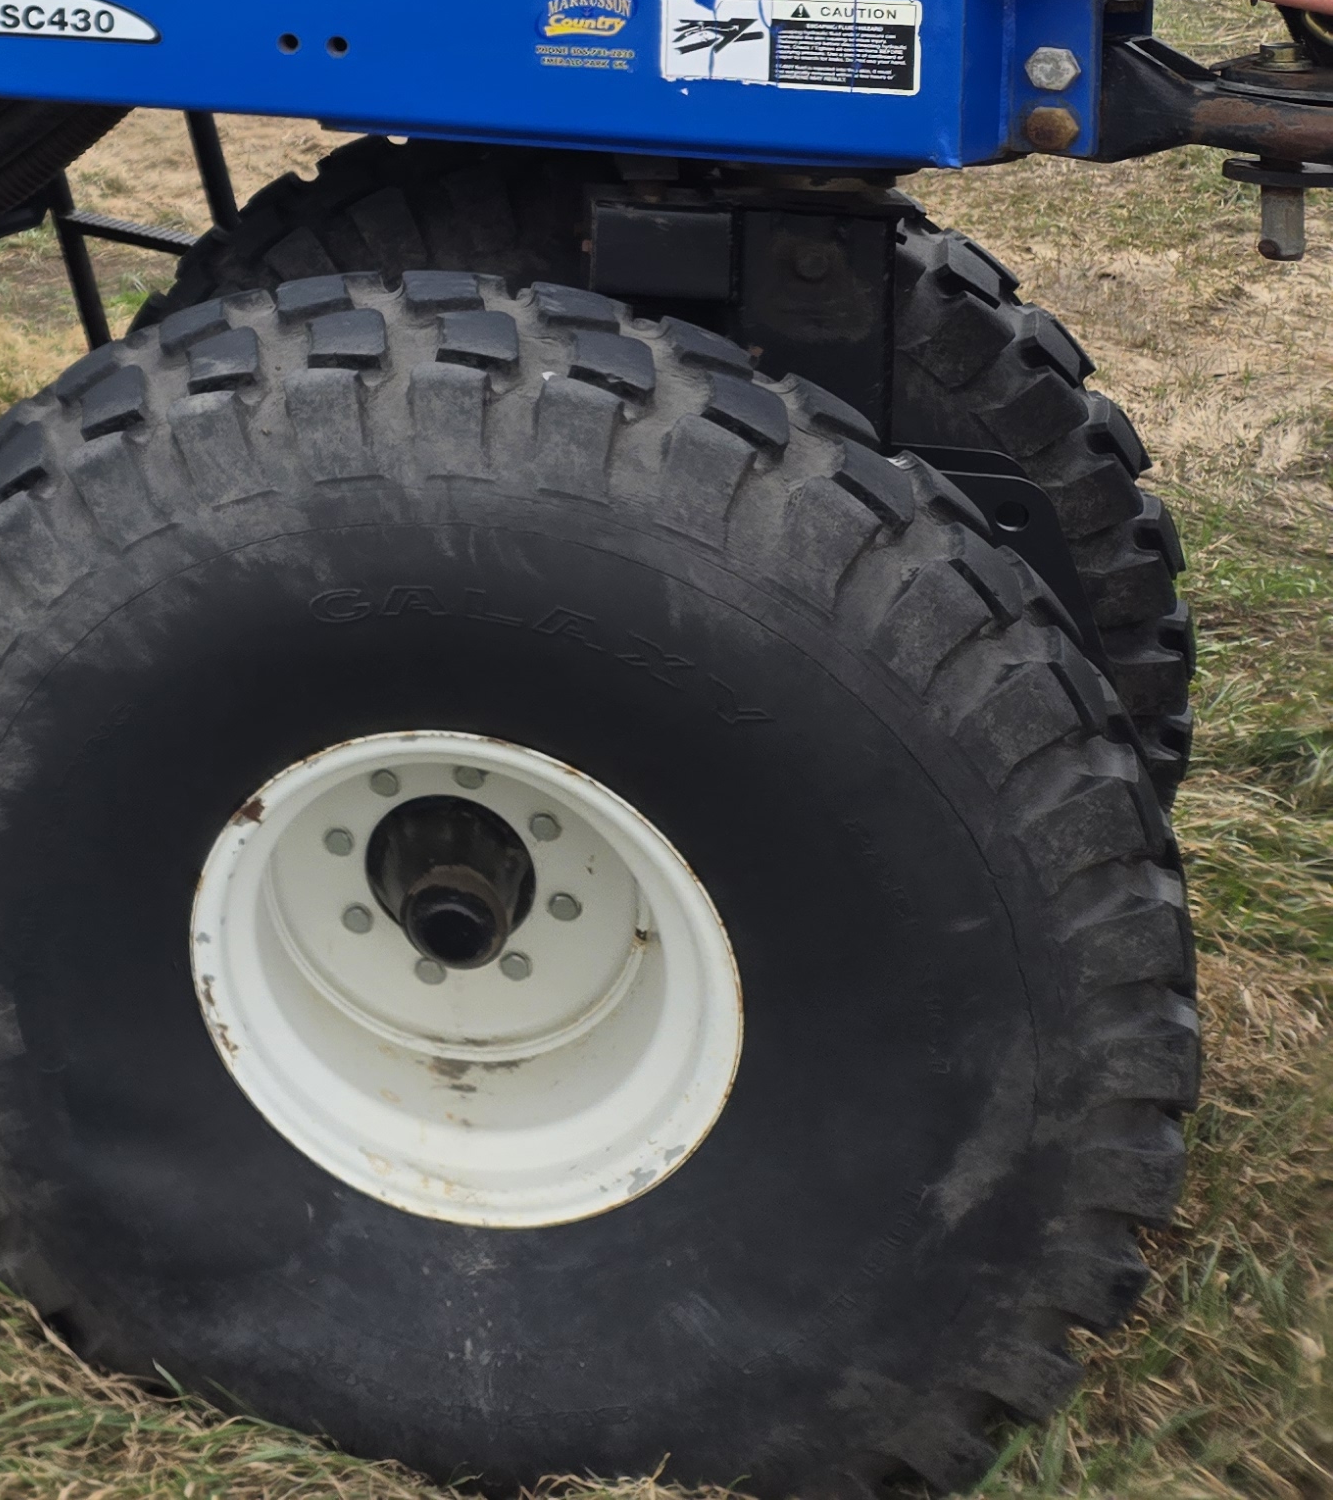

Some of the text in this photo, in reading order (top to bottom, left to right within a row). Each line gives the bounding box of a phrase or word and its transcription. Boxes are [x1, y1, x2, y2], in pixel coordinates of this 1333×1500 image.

[0, 3, 116, 35] SC430
[545, 13, 626, 37] Country
[820, 6, 897, 19] CAUTION
[308, 584, 776, 724] GALAXY
